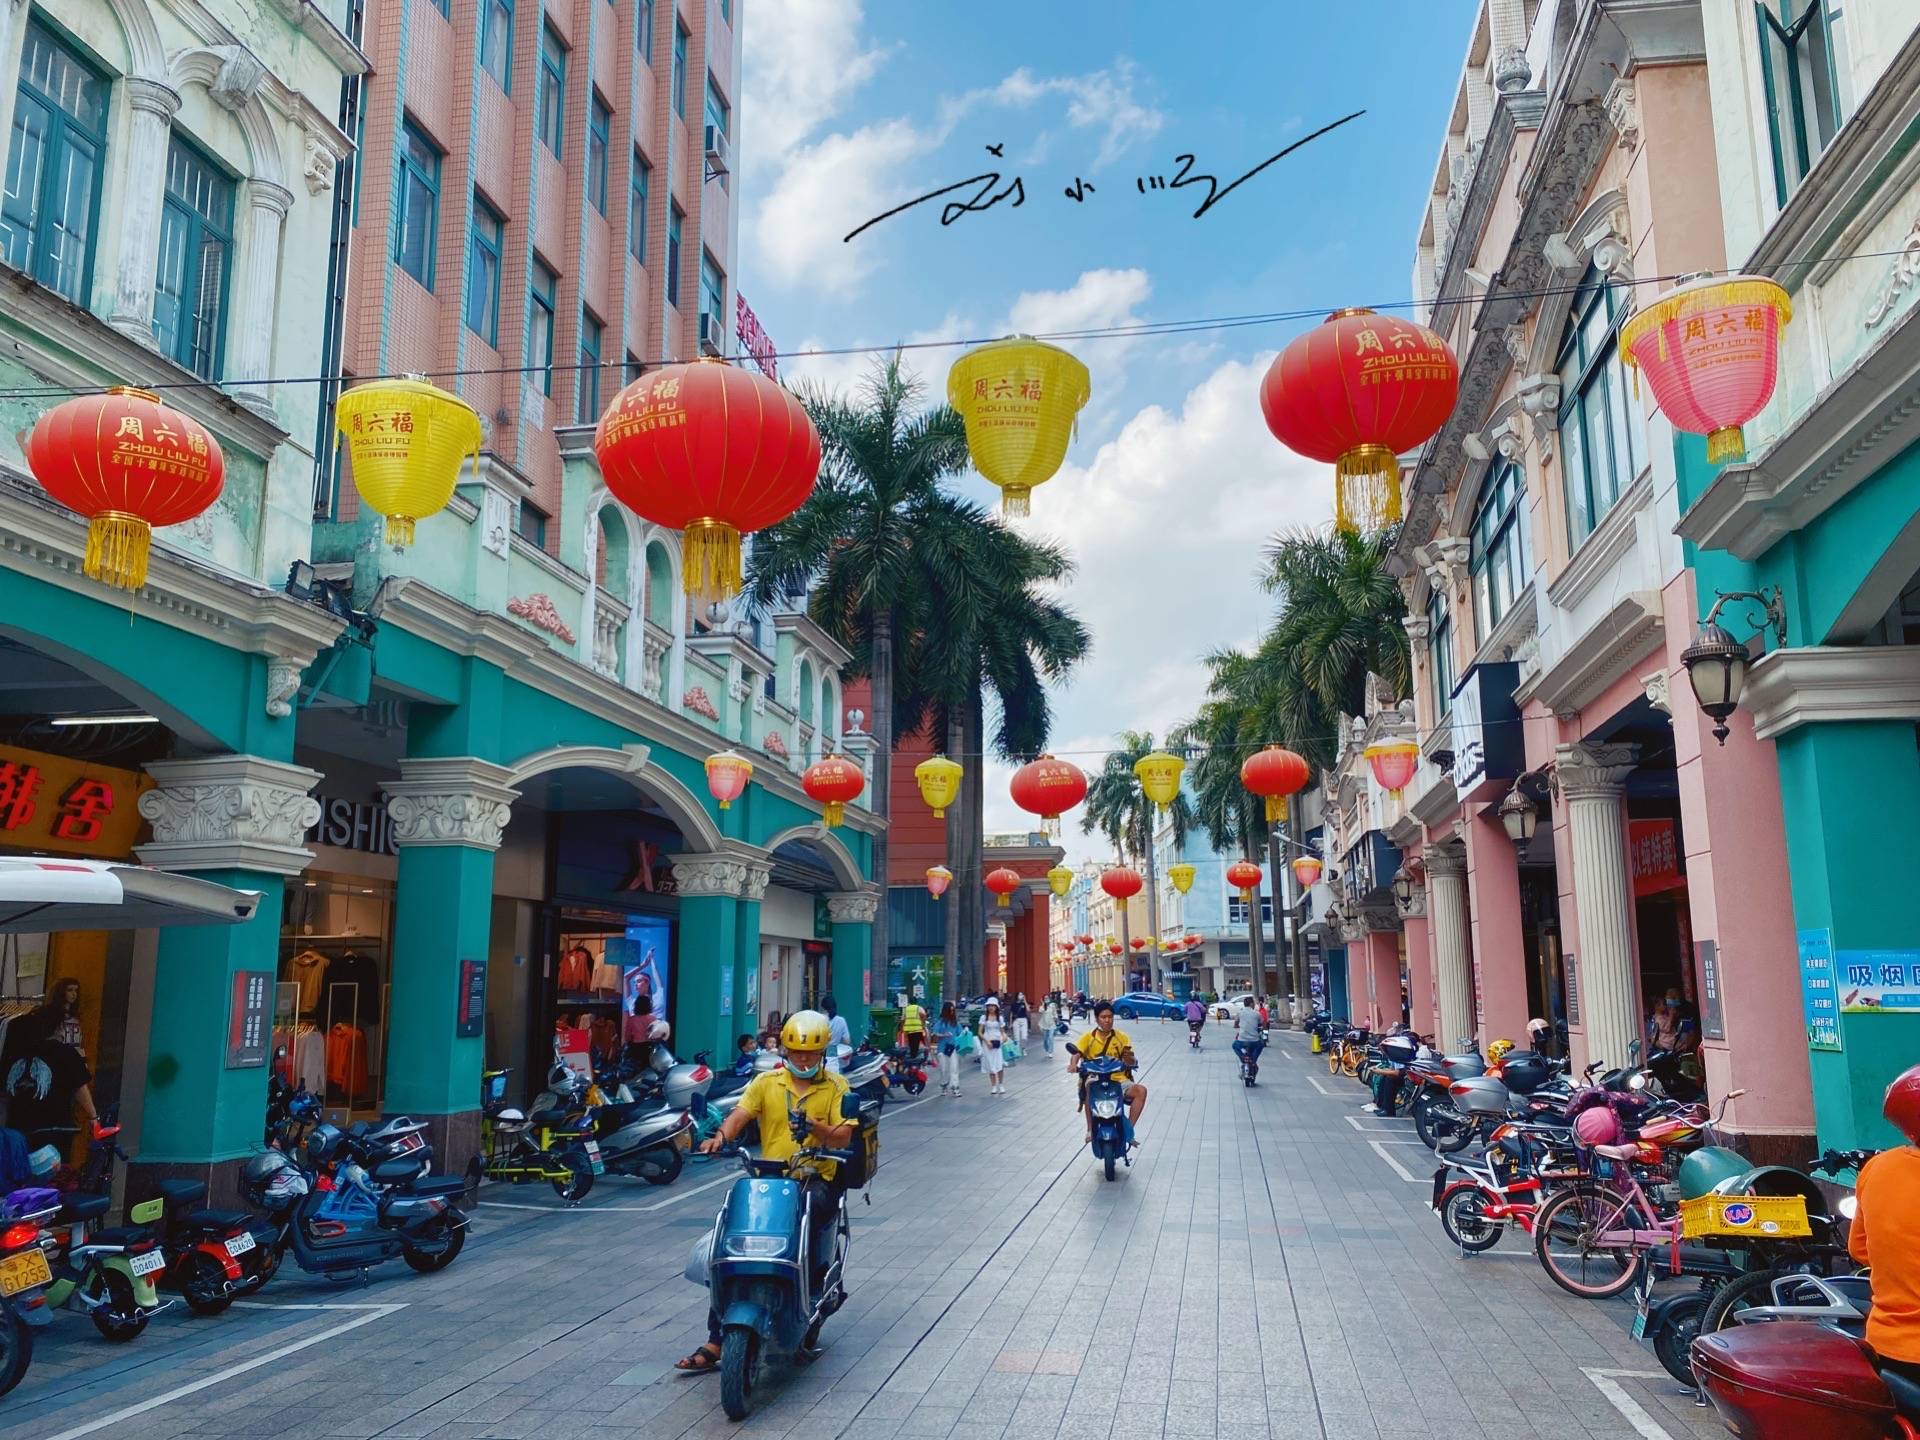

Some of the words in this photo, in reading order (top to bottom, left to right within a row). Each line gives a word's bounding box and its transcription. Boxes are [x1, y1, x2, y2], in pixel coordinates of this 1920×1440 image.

[1684, 307, 1764, 343] 周六福
[1355, 329, 1443, 357] 周六福
[1363, 352, 1406, 368] ZHOU
[1409, 352, 1430, 362] LIU
[1431, 353, 1446, 363] FU
[973, 377, 1042, 402] 周六福
[636, 404, 653, 417] LIU
[658, 401, 676, 411] FU
[352, 411, 414, 434] 周六福
[115, 416, 208, 456] 周六福
[376, 437, 392, 445] LIU
[395, 437, 410, 445] FU
[118, 441, 164, 456] ZHOU
[167, 449, 189, 462] LIU
[192, 456, 206, 468] FU
[1631, 828, 1677, 878] 以纯特卖
